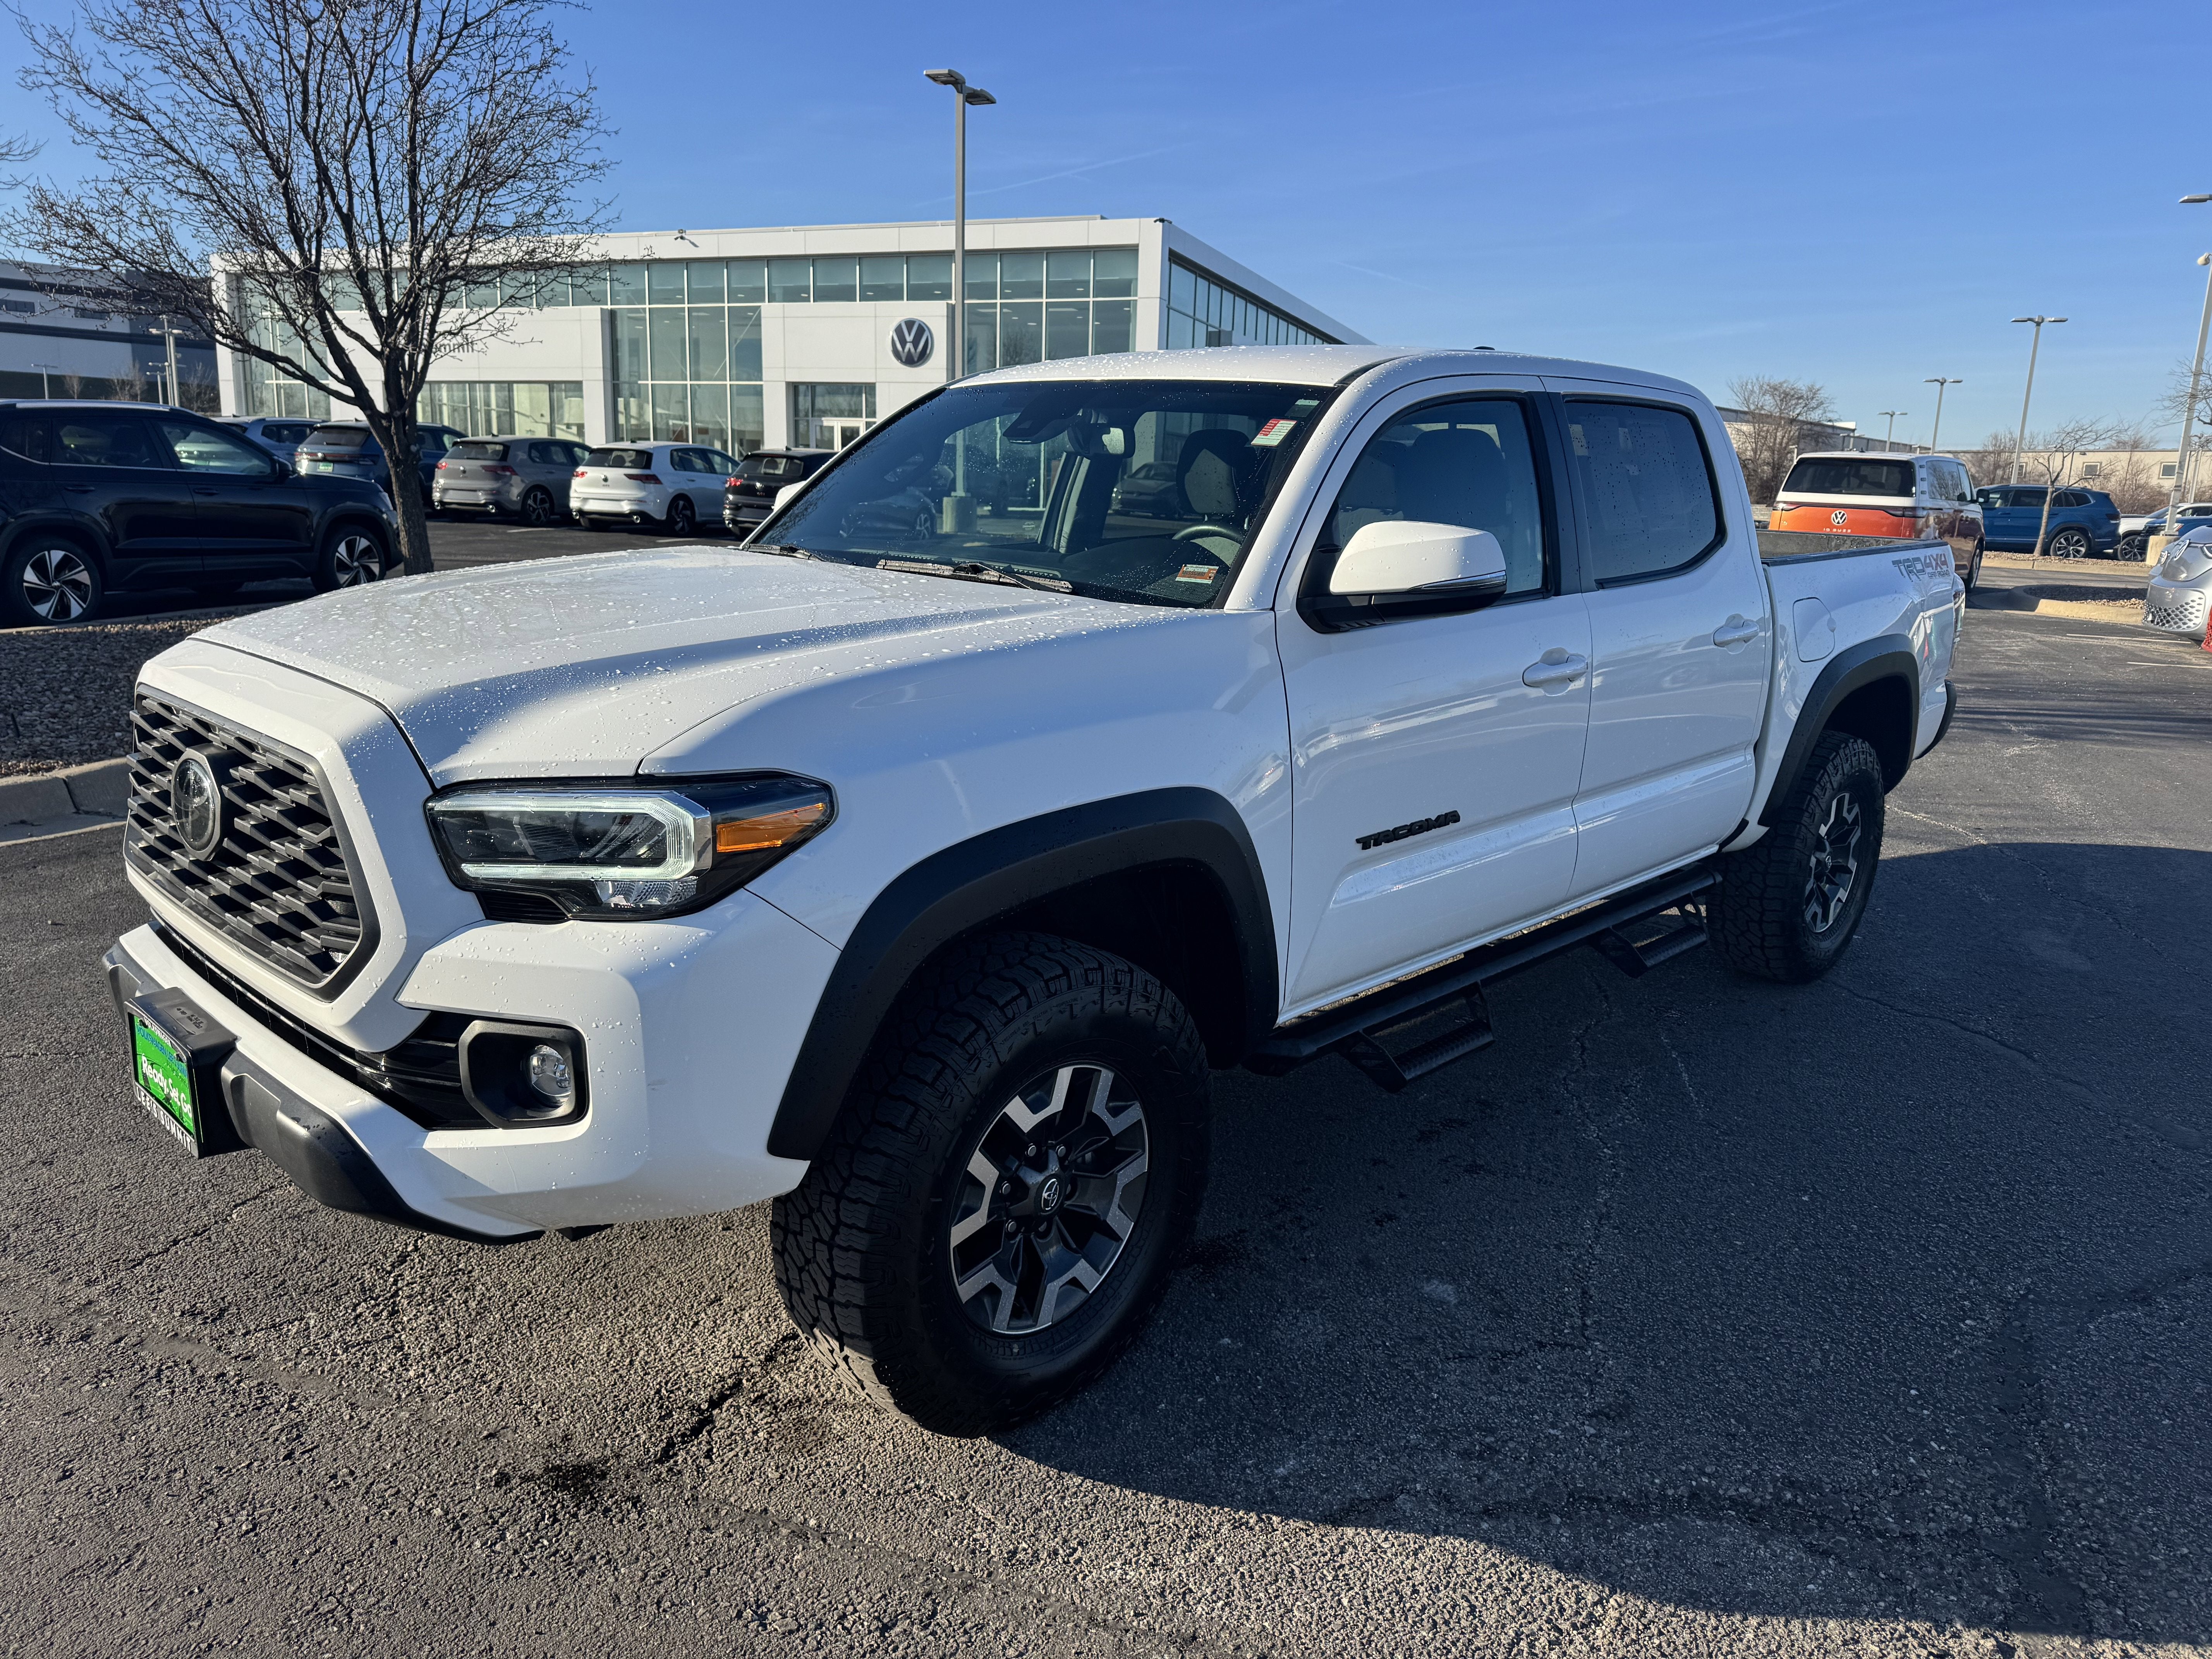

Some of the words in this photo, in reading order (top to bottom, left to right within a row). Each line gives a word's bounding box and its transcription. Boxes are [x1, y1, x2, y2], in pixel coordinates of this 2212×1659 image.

[1892, 556, 1927, 582] TRD
[1355, 810, 1461, 850] TACOMA
[137, 1087, 158, 1118] LEE'S
[160, 1110, 191, 1152] SUMMIT
